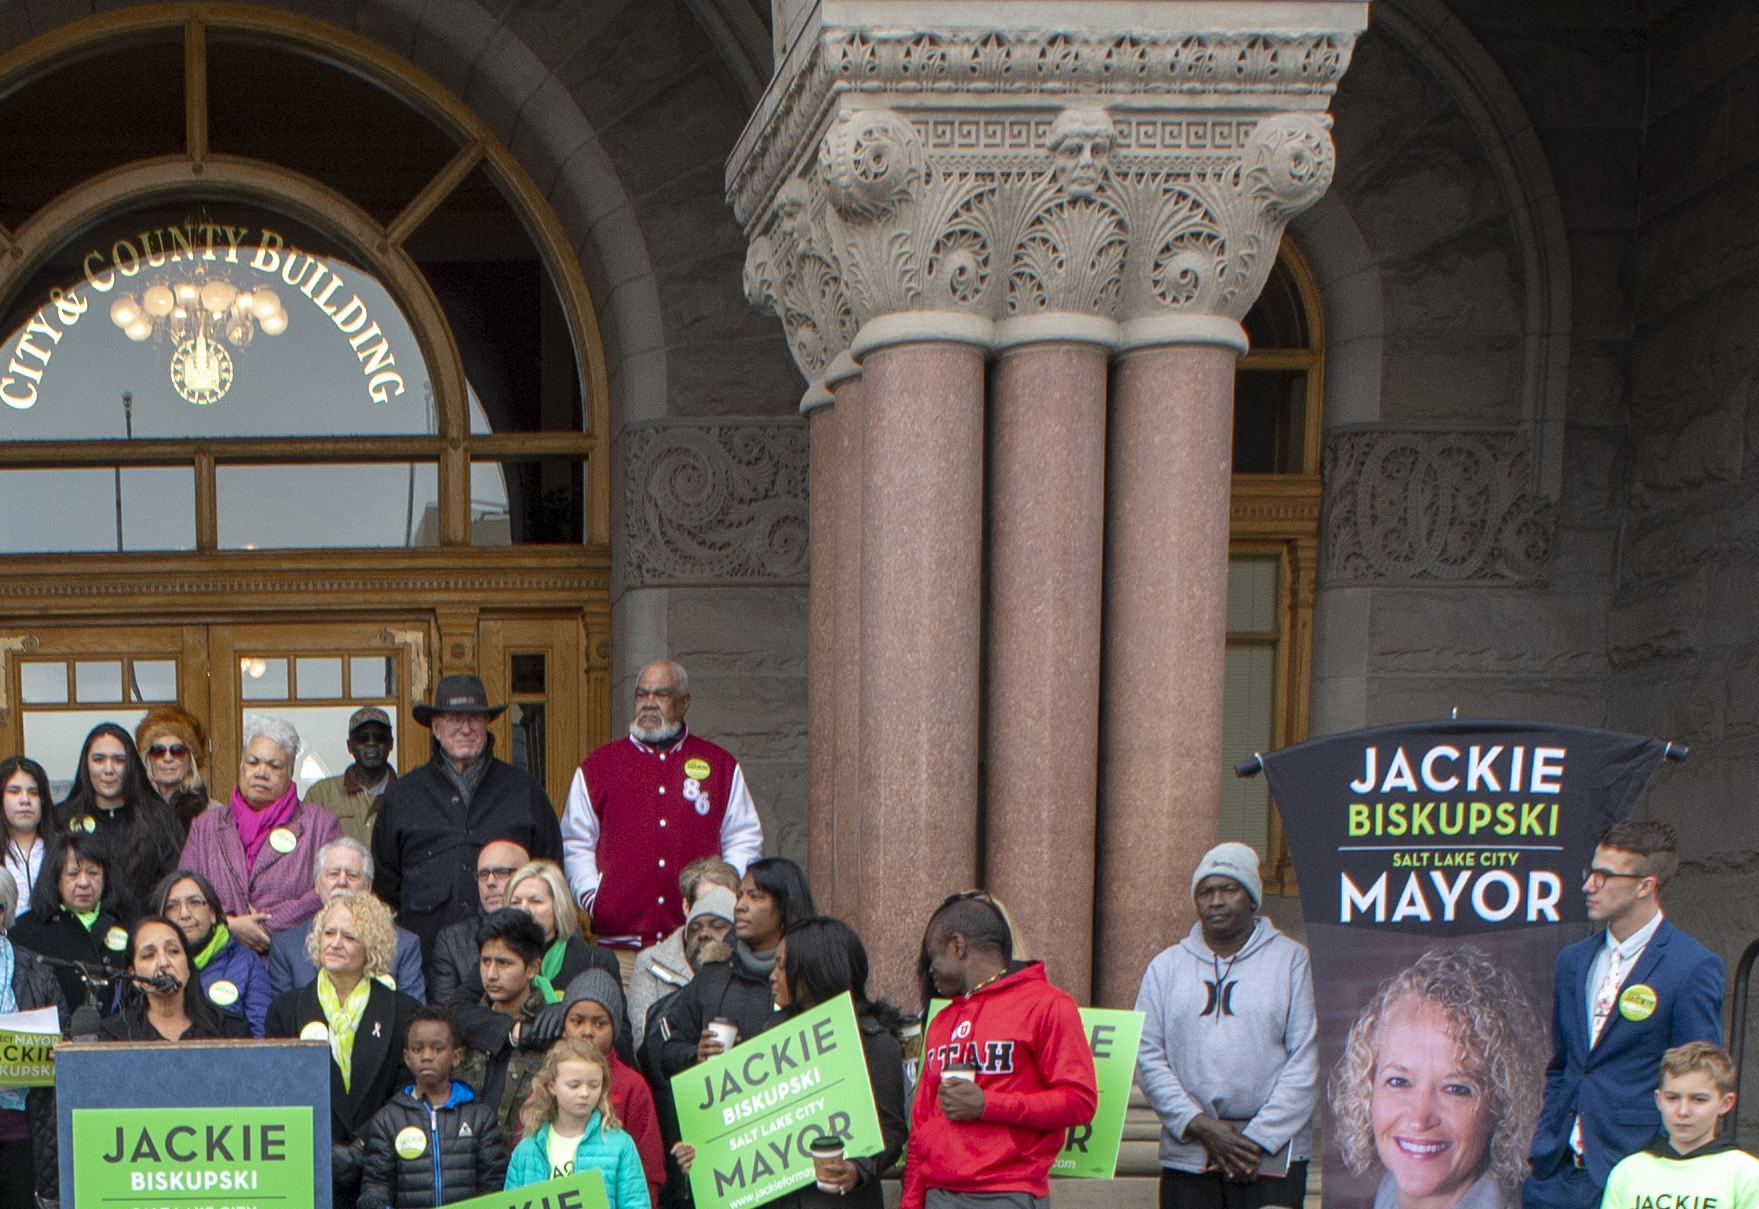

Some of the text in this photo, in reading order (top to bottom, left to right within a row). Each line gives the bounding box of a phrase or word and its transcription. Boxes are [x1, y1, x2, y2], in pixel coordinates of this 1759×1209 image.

[49, 286, 88, 326] &
[83, 225, 249, 293] COUNTY
[249, 228, 405, 405] BUILDING
[1349, 745, 1567, 794] JACKIE
[1348, 802, 1559, 836] BISKUPSKI
[1393, 852, 1520, 867] SALT LAKE CITY
[1340, 870, 1563, 922] MAYOR
[699, 1017, 837, 1110] JACKIE
[722, 1066, 821, 1126] BISKUPSKI
[102, 1125, 286, 1163] JACKIE
[729, 1098, 825, 1151] SALT LAKE CITY
[713, 1111, 854, 1198] MAYOR
[131, 1171, 257, 1191] BISKUPSKI
